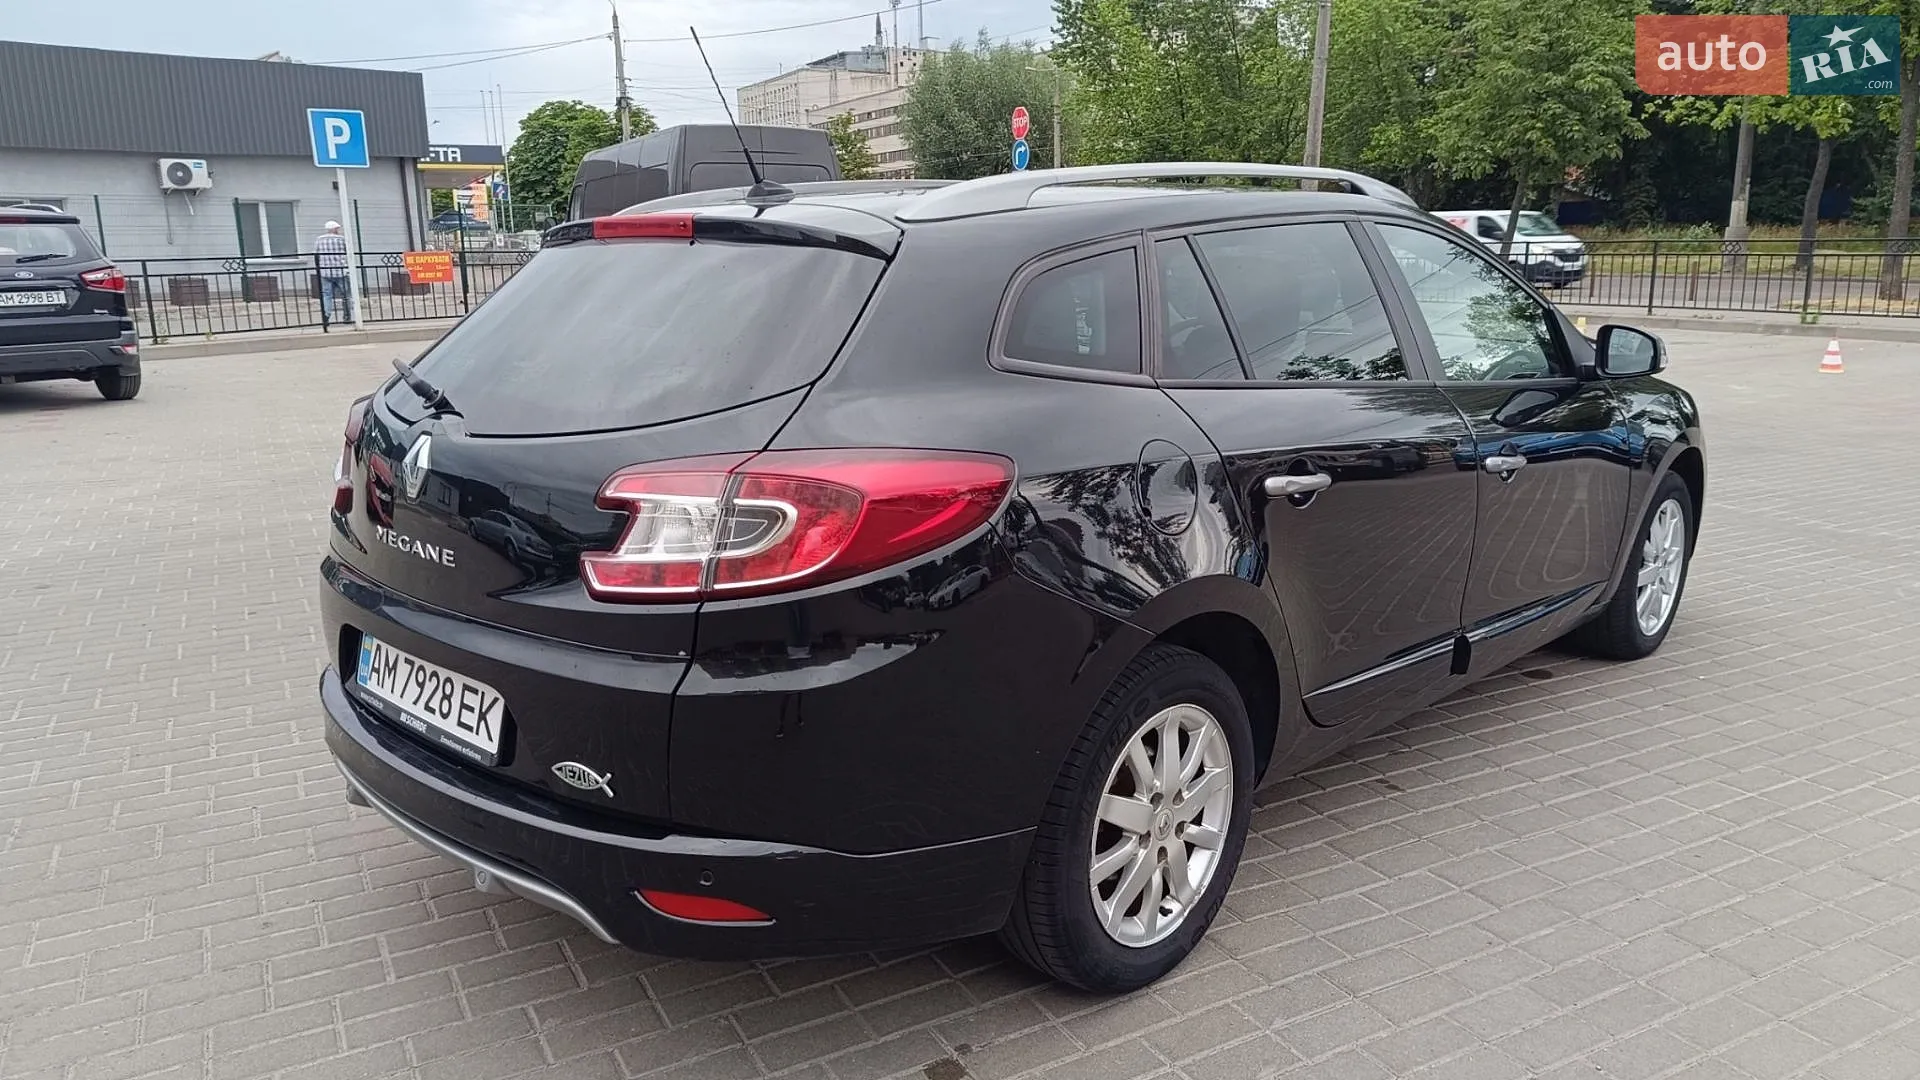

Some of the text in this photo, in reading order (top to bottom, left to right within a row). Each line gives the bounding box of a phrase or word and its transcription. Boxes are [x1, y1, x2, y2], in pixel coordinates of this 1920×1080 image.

[1013, 116, 1028, 128] STOP
[323, 117, 351, 159] P
[18, 292, 43, 304] 2998
[46, 290, 61, 303] BT
[375, 524, 456, 568] MEGANE
[368, 643, 500, 743] AM 7928 EK
[560, 766, 596, 787] JEZUS
